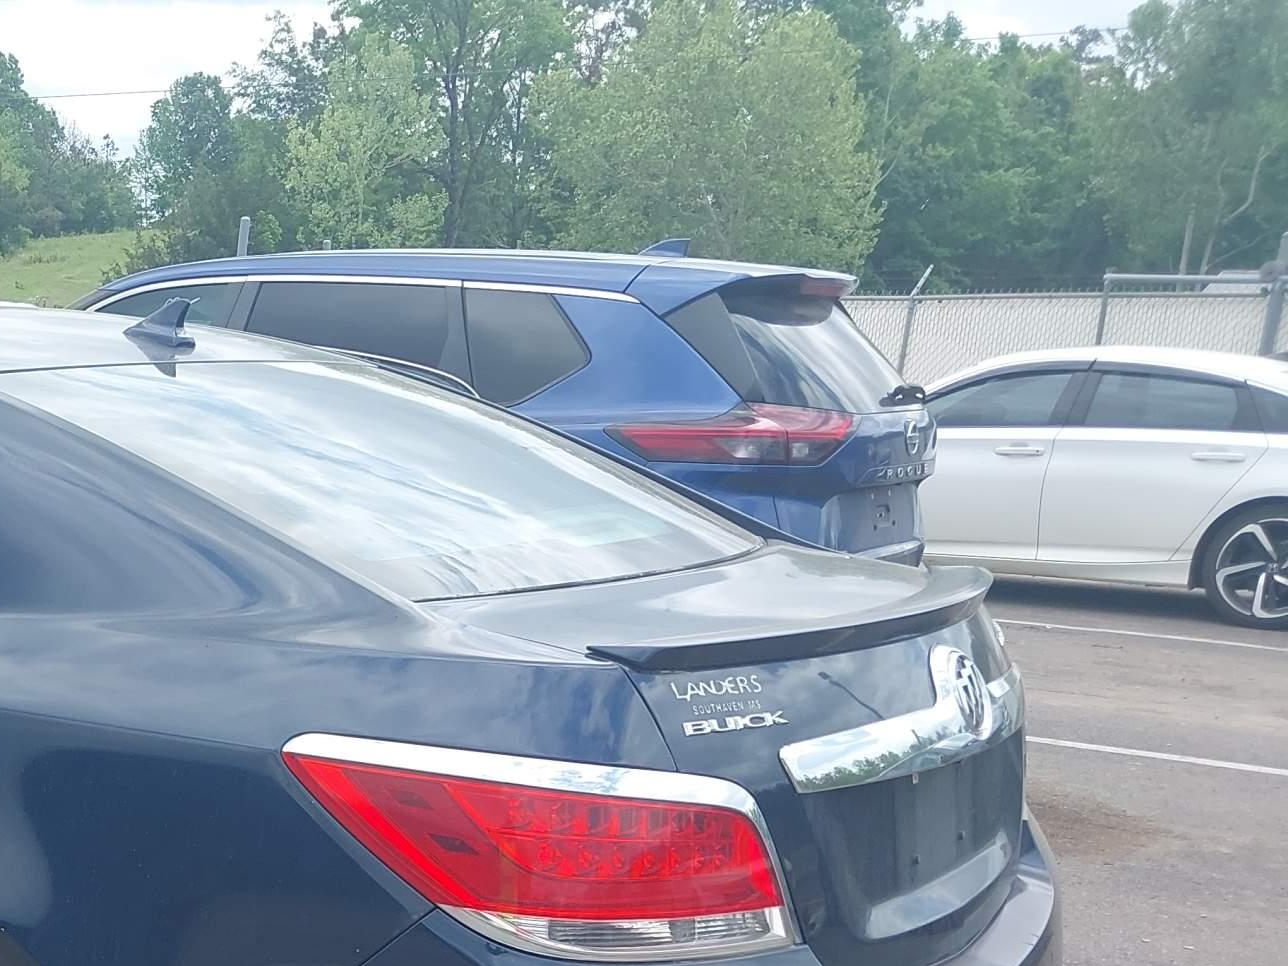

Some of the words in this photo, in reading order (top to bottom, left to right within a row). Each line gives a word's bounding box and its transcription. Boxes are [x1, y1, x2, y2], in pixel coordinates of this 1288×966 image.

[886, 463, 929, 480] ROGUE
[670, 674, 762, 702] LANDERS
[692, 702, 744, 715] SOUTHAVEN
[682, 710, 790, 737] BUICK
